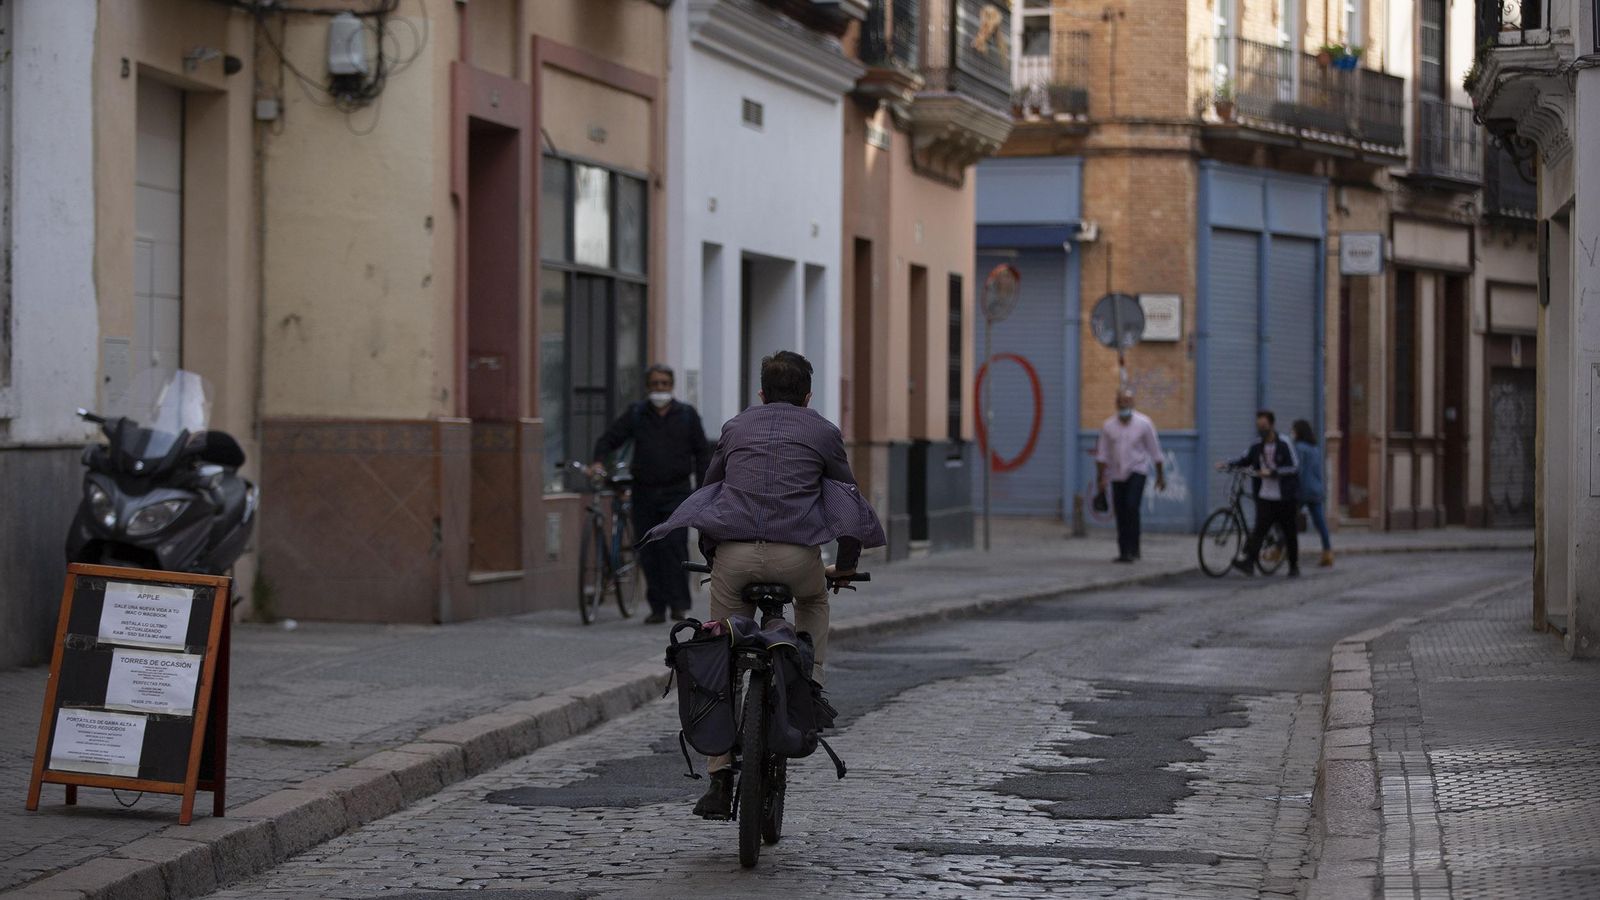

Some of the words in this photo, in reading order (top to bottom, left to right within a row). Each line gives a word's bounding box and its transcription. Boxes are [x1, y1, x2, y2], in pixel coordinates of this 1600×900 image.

[137, 593, 160, 601] APPLE
[121, 657, 148, 665] TORRES
[161, 660, 192, 668] OCASIÓN
